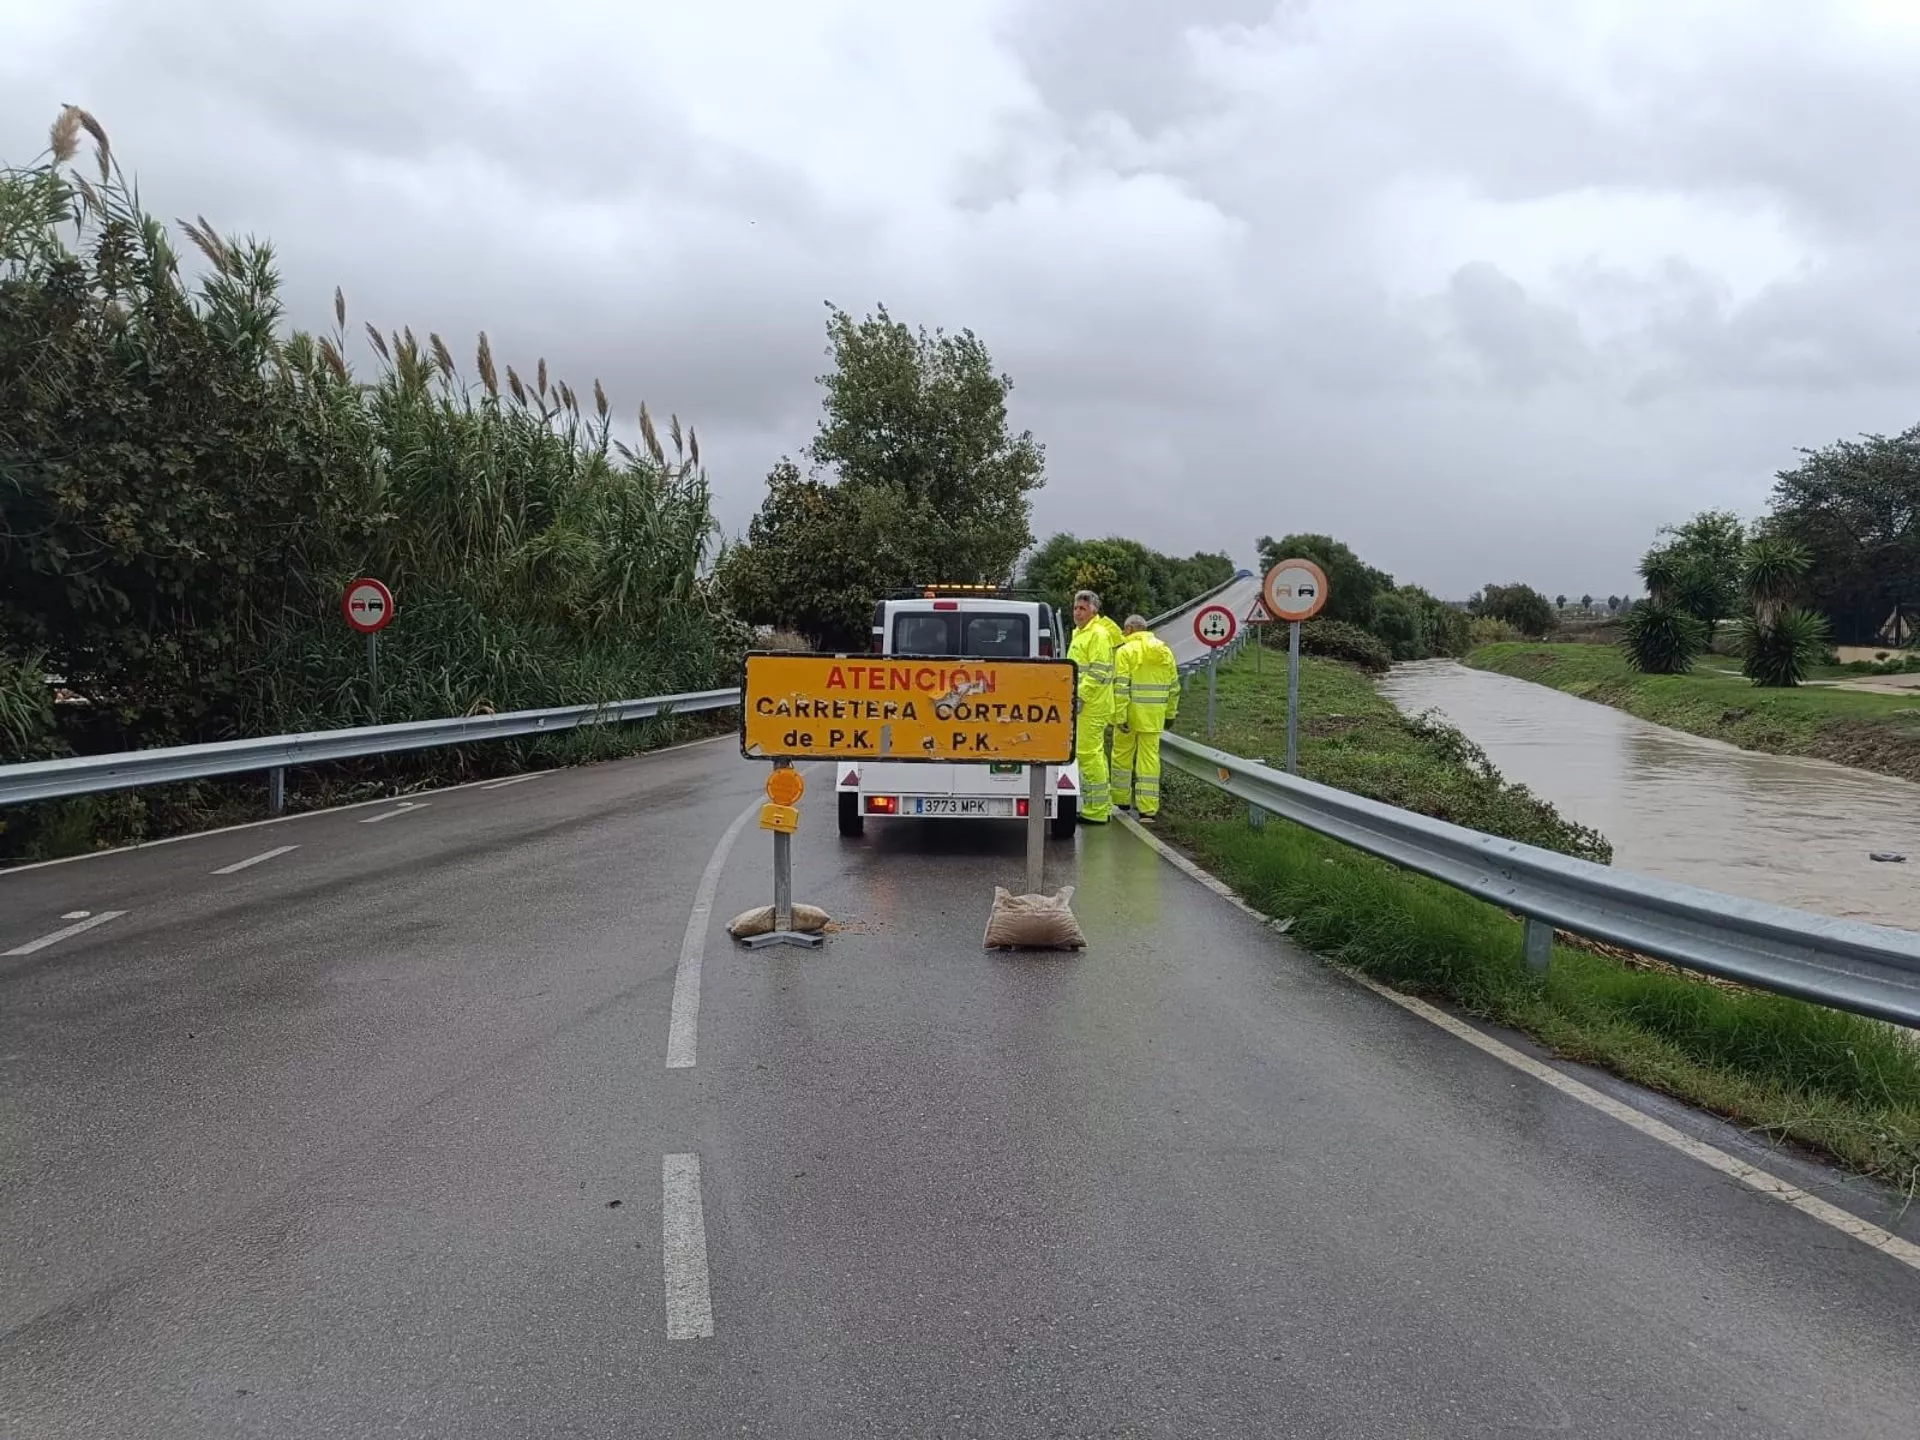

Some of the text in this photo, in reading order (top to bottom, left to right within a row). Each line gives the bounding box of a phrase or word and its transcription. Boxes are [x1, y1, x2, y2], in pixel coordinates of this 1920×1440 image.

[756, 697, 1061, 724] CARRETERA CORTADA
[783, 729, 813, 747] de
[829, 729, 874, 748] P.K.
[952, 732, 999, 751] P.K.
[925, 801, 985, 812] 3773 MPK
